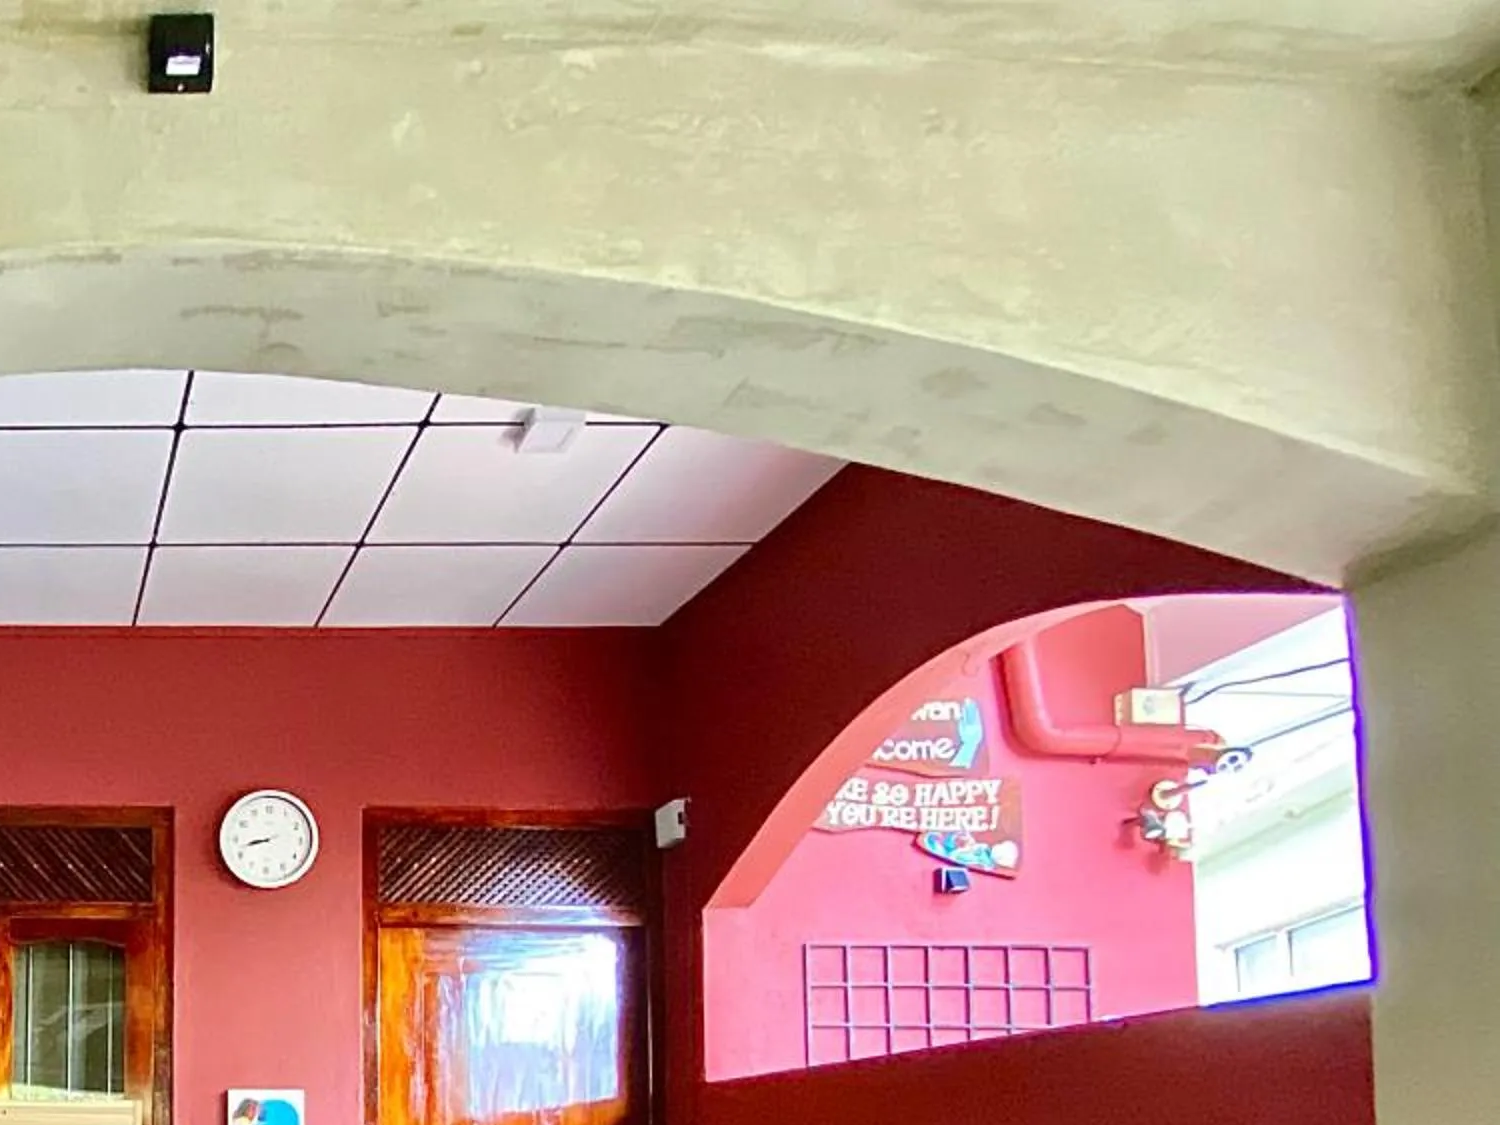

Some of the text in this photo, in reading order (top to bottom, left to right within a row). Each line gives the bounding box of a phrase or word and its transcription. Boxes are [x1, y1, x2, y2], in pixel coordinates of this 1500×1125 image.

[872, 737, 957, 761] come
[872, 782, 909, 805] SO
[913, 779, 1002, 806] HAPPY
[825, 800, 1000, 831] YOU'RE HERE!
